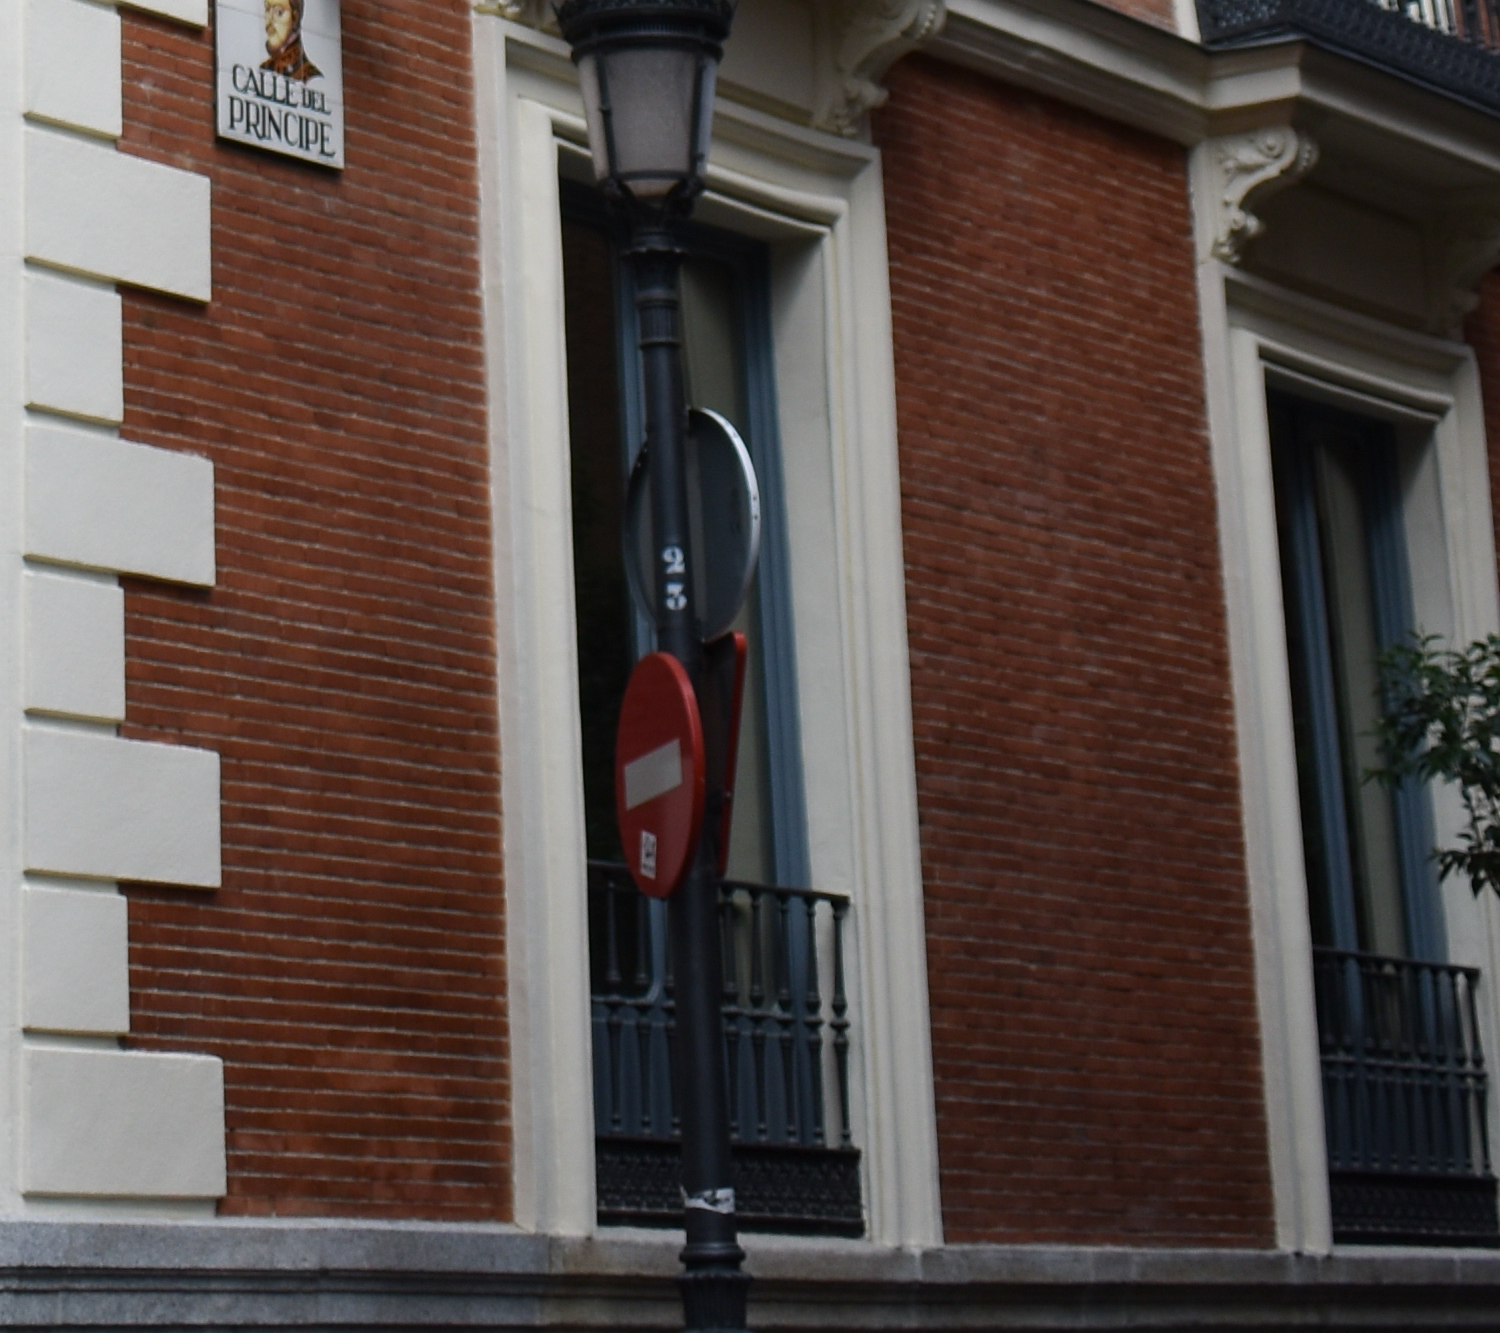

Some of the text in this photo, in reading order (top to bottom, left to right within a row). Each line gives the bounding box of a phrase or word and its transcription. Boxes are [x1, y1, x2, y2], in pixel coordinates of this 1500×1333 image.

[231, 63, 332, 117] CALLE DEL
[228, 94, 336, 158] PRINCIPE
